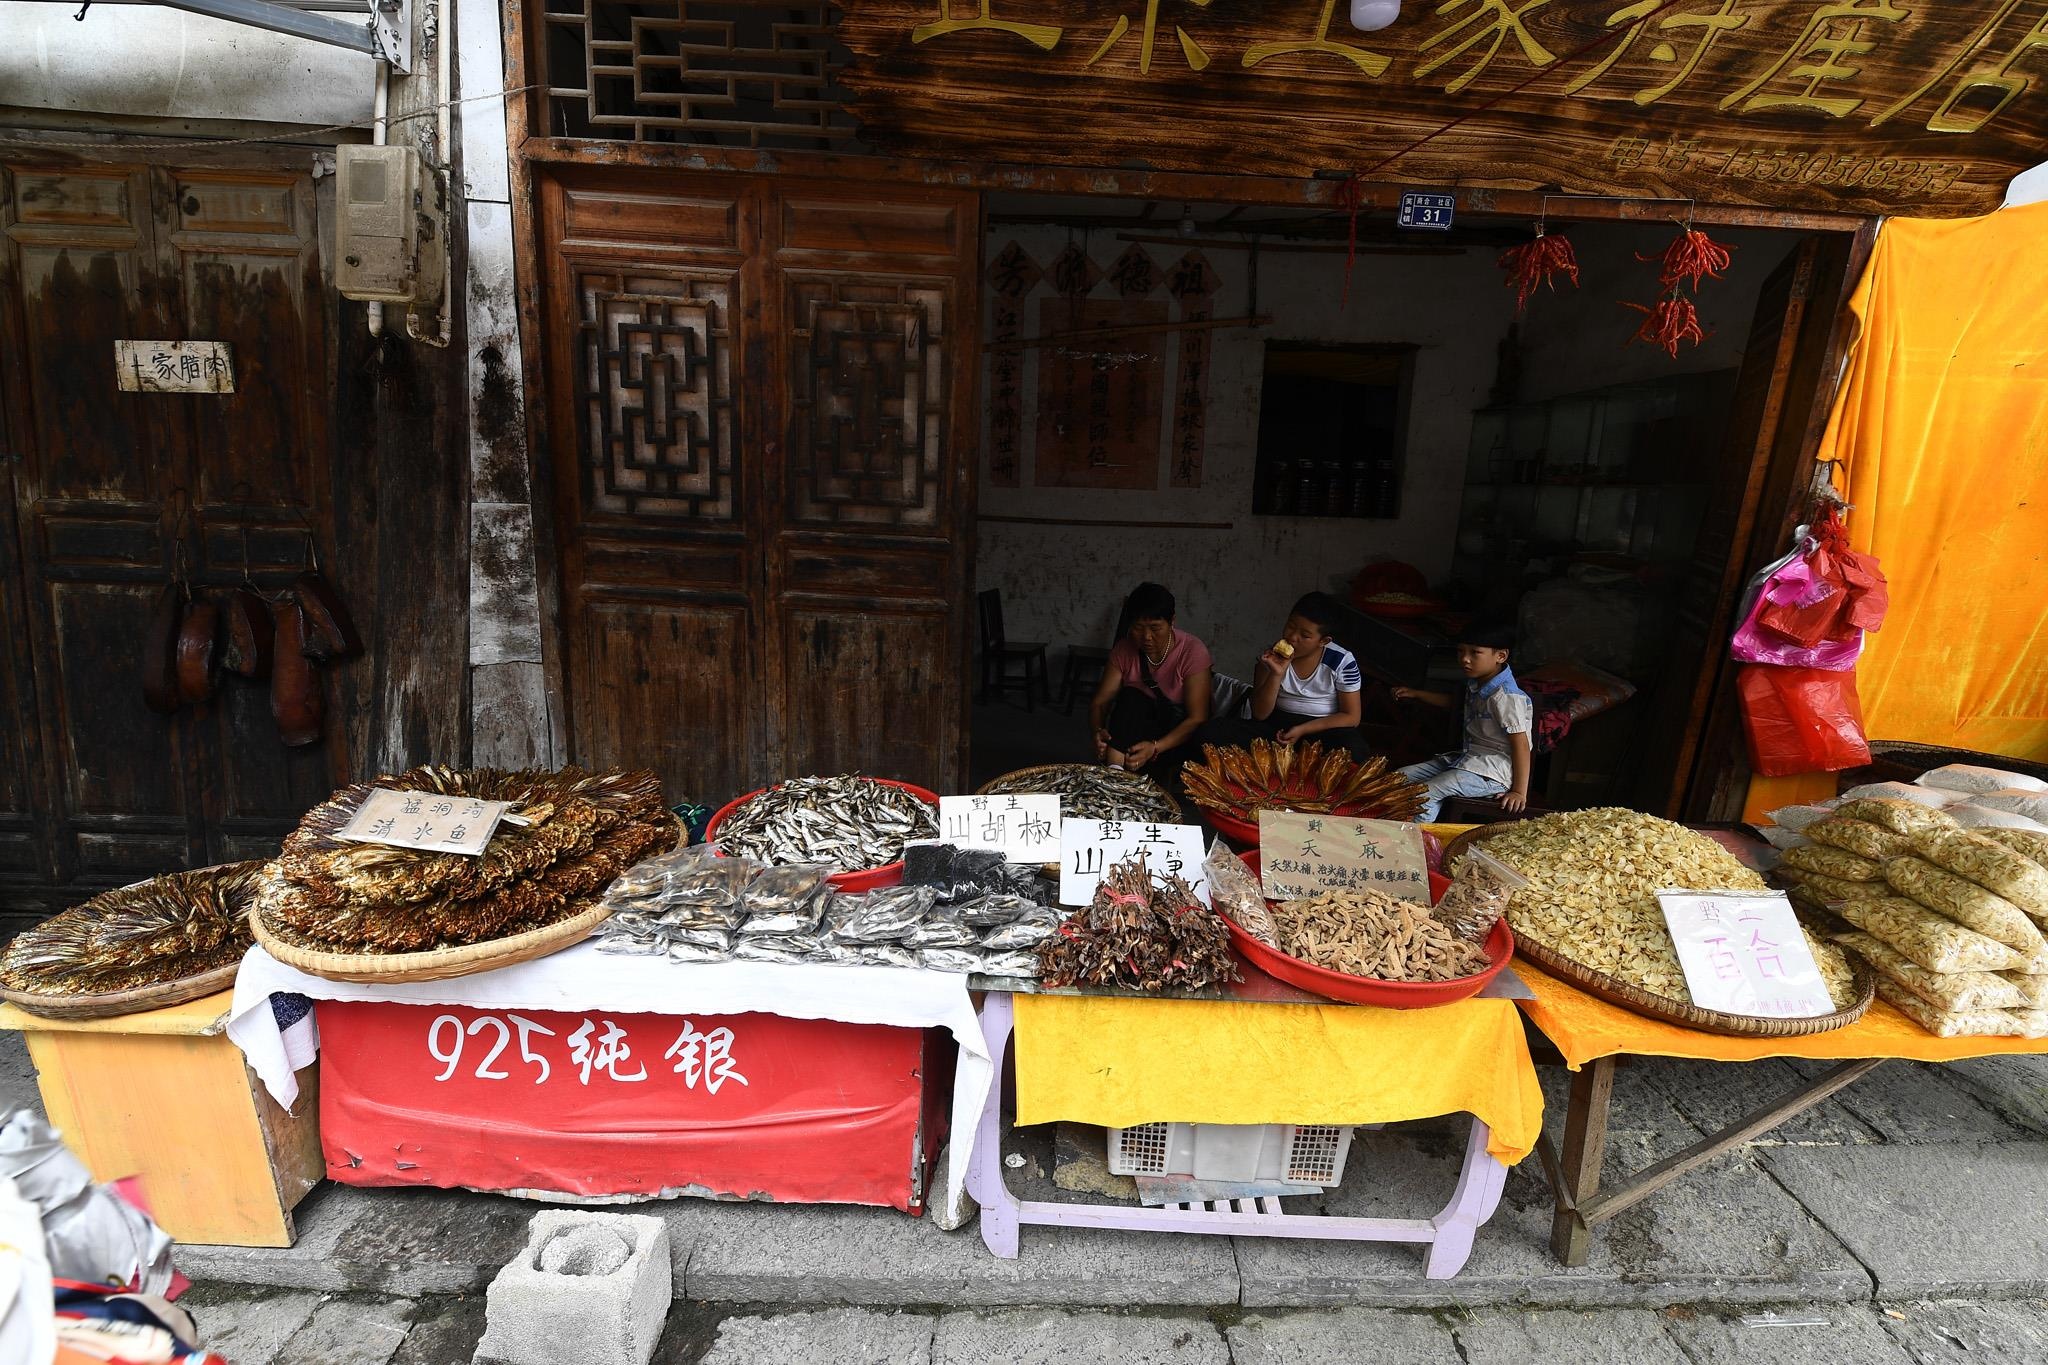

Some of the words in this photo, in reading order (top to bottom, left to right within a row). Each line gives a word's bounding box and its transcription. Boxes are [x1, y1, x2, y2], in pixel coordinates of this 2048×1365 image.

[1423, 209, 1440, 222] 31
[402, 797, 485, 819] 猛洞河
[972, 795, 1024, 811] 野生
[368, 816, 468, 845] 清水鱼
[949, 810, 1060, 847] 山胡椒
[1098, 822, 1176, 845] 野生
[1308, 819, 1368, 837] 野生
[1301, 839, 1385, 860] 天麻
[1703, 928, 1787, 980] 百合
